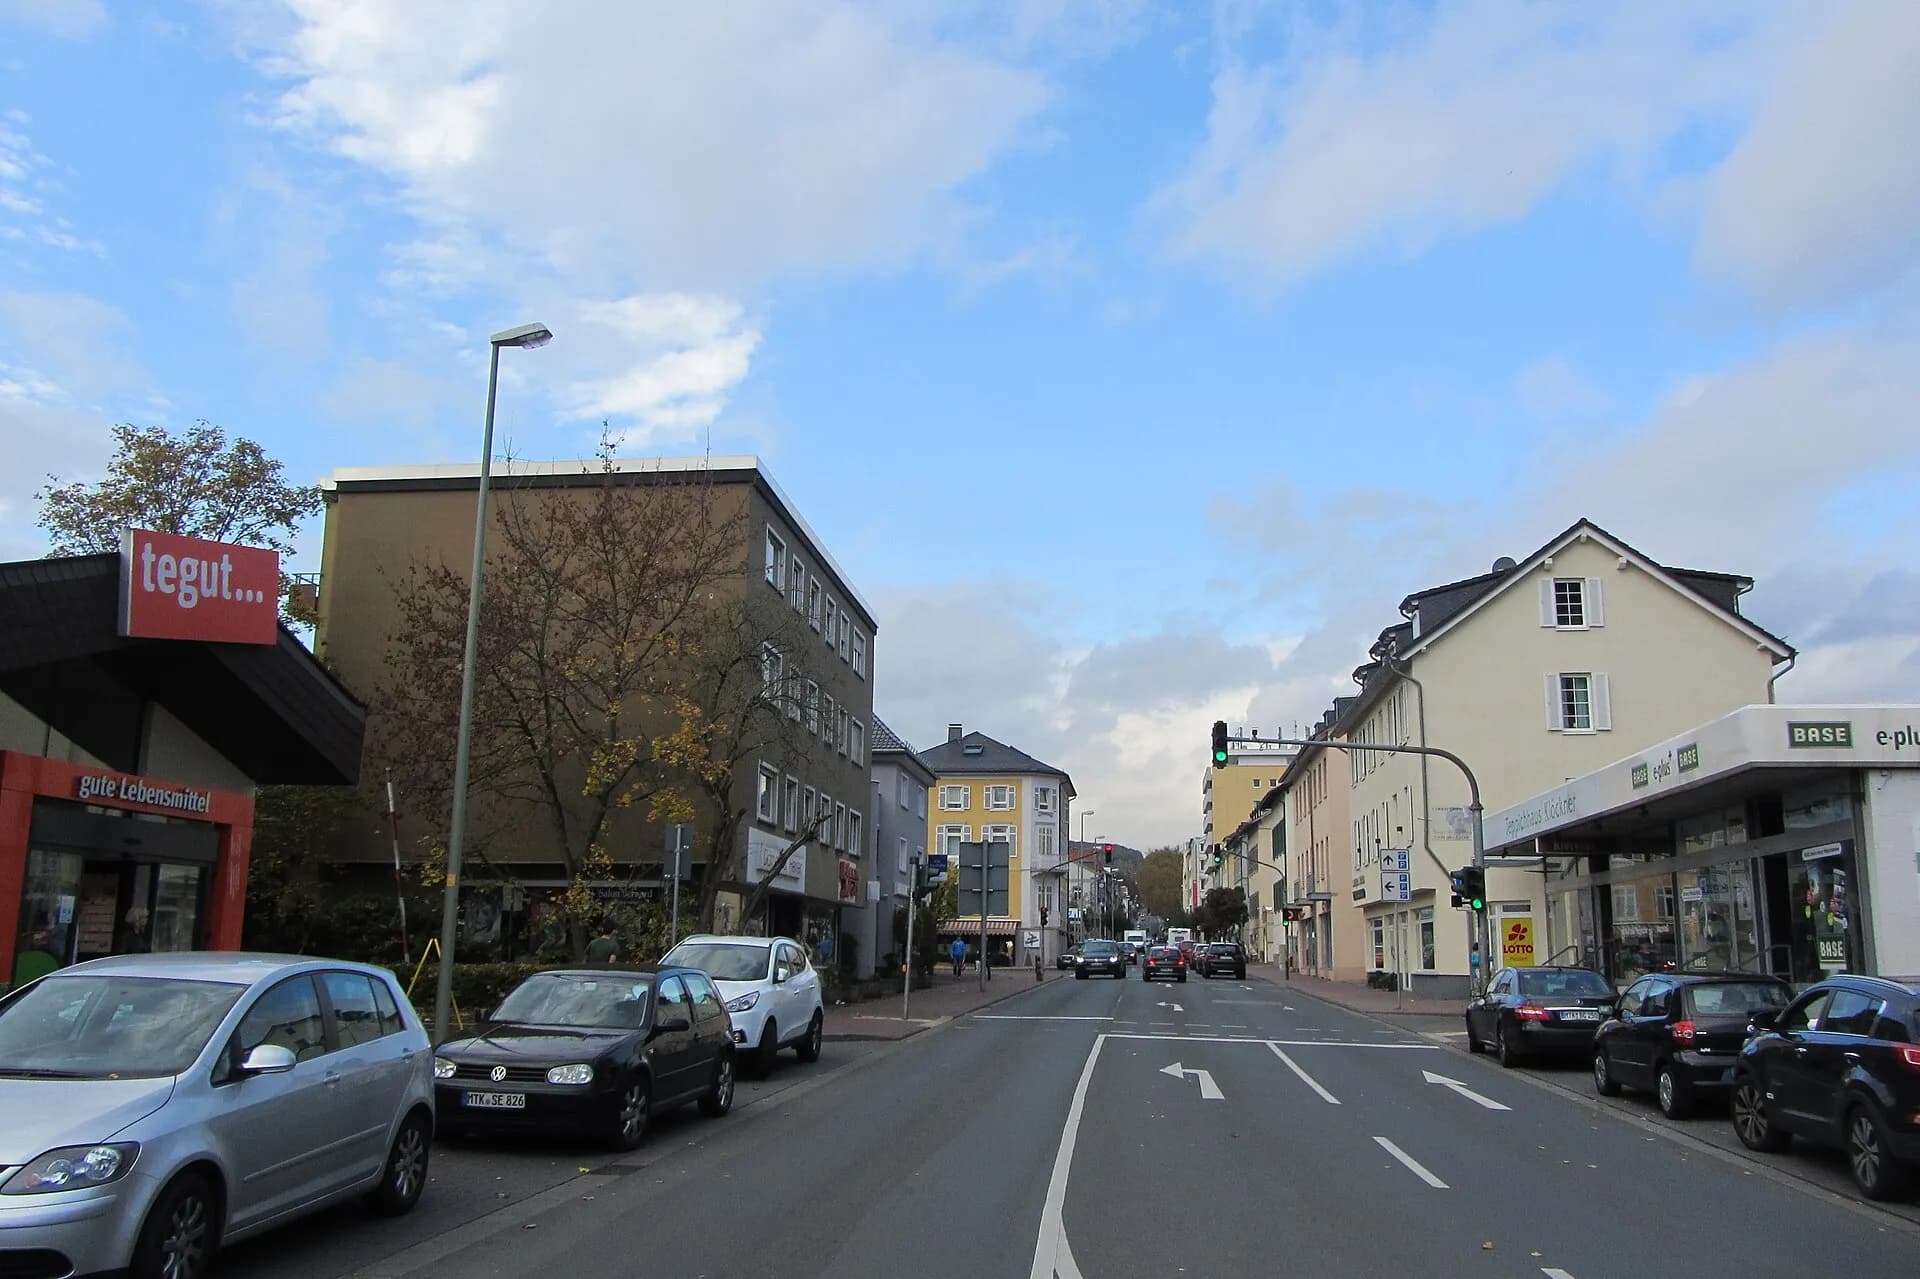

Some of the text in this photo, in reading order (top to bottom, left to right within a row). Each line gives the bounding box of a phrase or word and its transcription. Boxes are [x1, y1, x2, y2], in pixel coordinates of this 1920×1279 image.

[141, 543, 264, 608] tegut...
[1793, 727, 1848, 742] BASE
[1633, 767, 1647, 785] BASE
[1679, 748, 1697, 768] BASE
[79, 775, 211, 813] gute Lebensmittel
[1503, 944, 1534, 954] LOTTO
[1819, 941, 1844, 957] BASE
[467, 1093, 524, 1107] MTK SE 826
